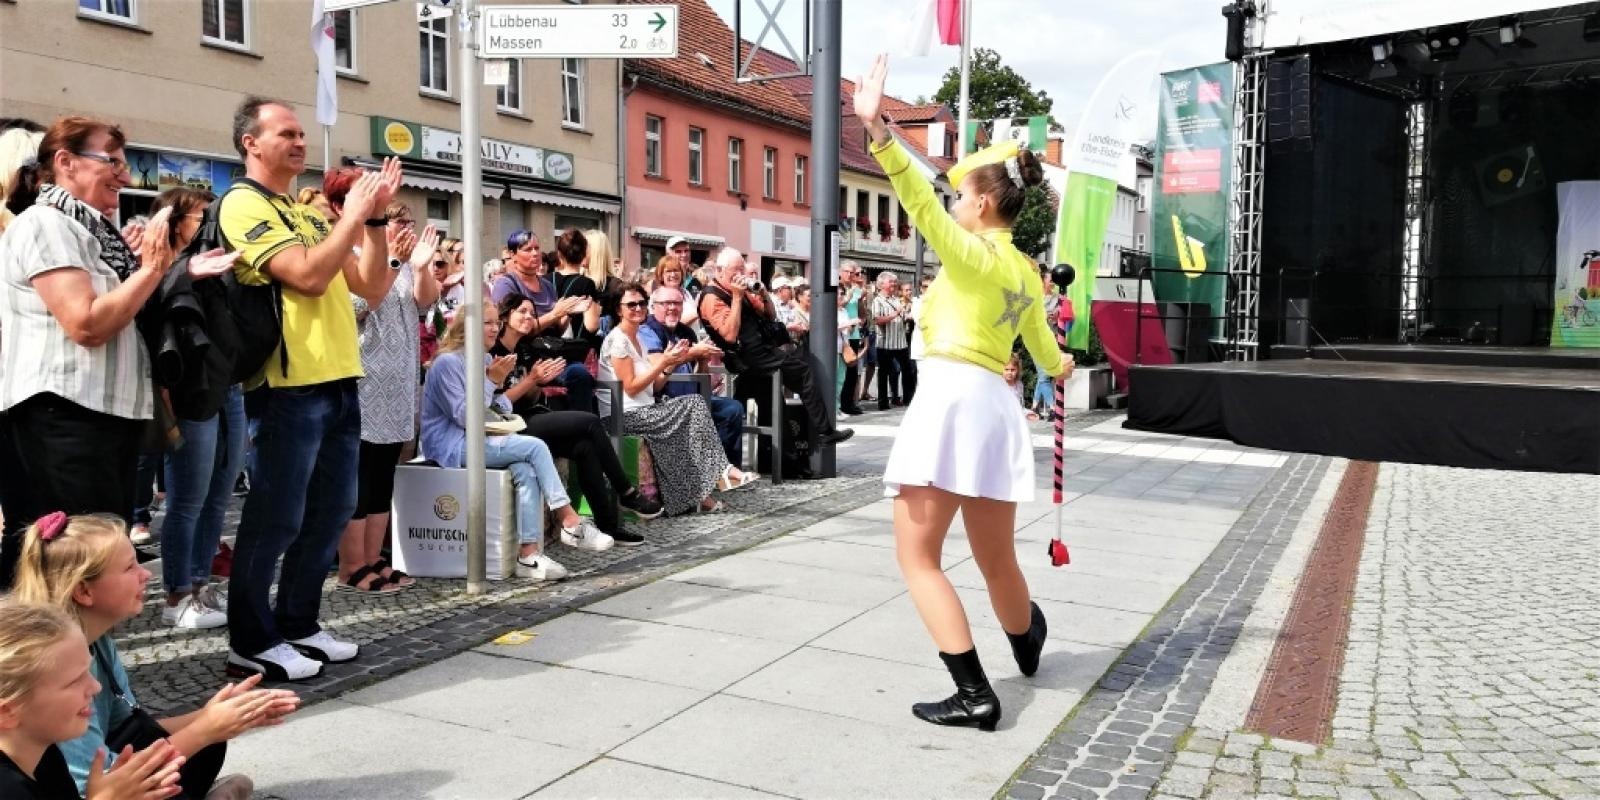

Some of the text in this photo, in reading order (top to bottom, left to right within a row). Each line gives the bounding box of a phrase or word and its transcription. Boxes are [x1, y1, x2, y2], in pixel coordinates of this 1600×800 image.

[490, 14, 628, 28] Lübbenau 33
[490, 35, 542, 49] Massen
